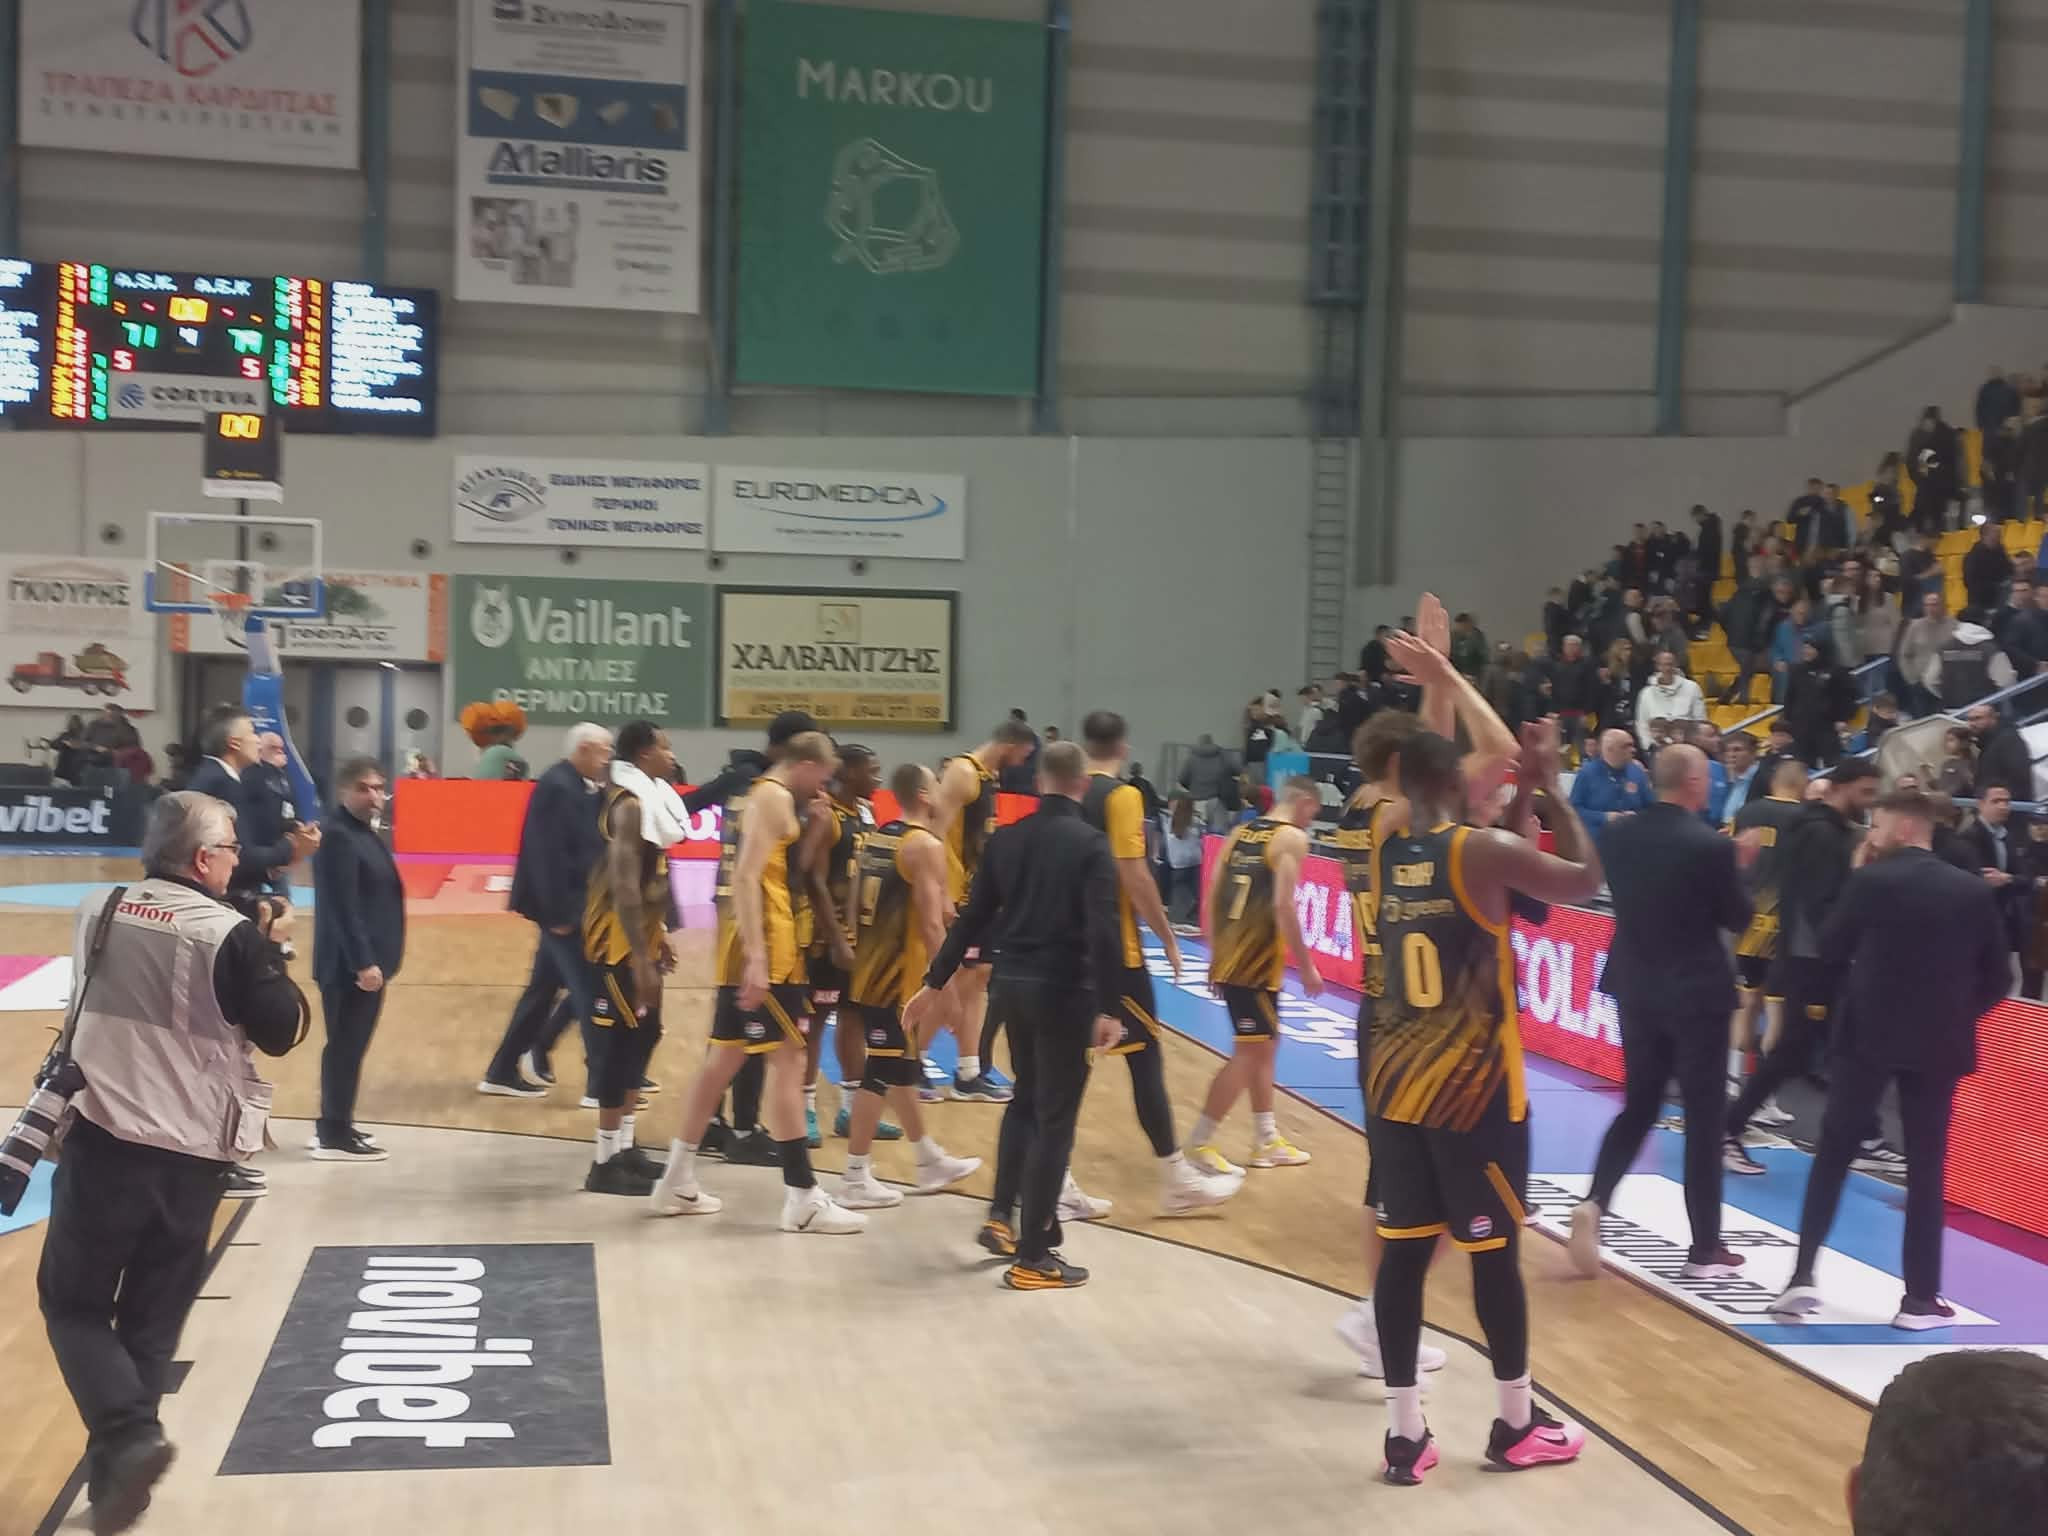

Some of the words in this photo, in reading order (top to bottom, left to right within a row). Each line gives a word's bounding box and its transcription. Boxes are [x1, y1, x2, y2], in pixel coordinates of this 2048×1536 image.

[797, 57, 994, 113] MARKOU
[150, 385, 258, 407] CORTEVA
[219, 413, 262, 439] 00
[516, 595, 692, 648] Vaillant
[524, 656, 638, 682] ΑΝΤΛΙΕΣ
[731, 642, 942, 674] ΧΑΛΒΑΝΤΖΗΣ
[1402, 931, 1444, 1009] 0
[310, 1255, 535, 1449] novibet
